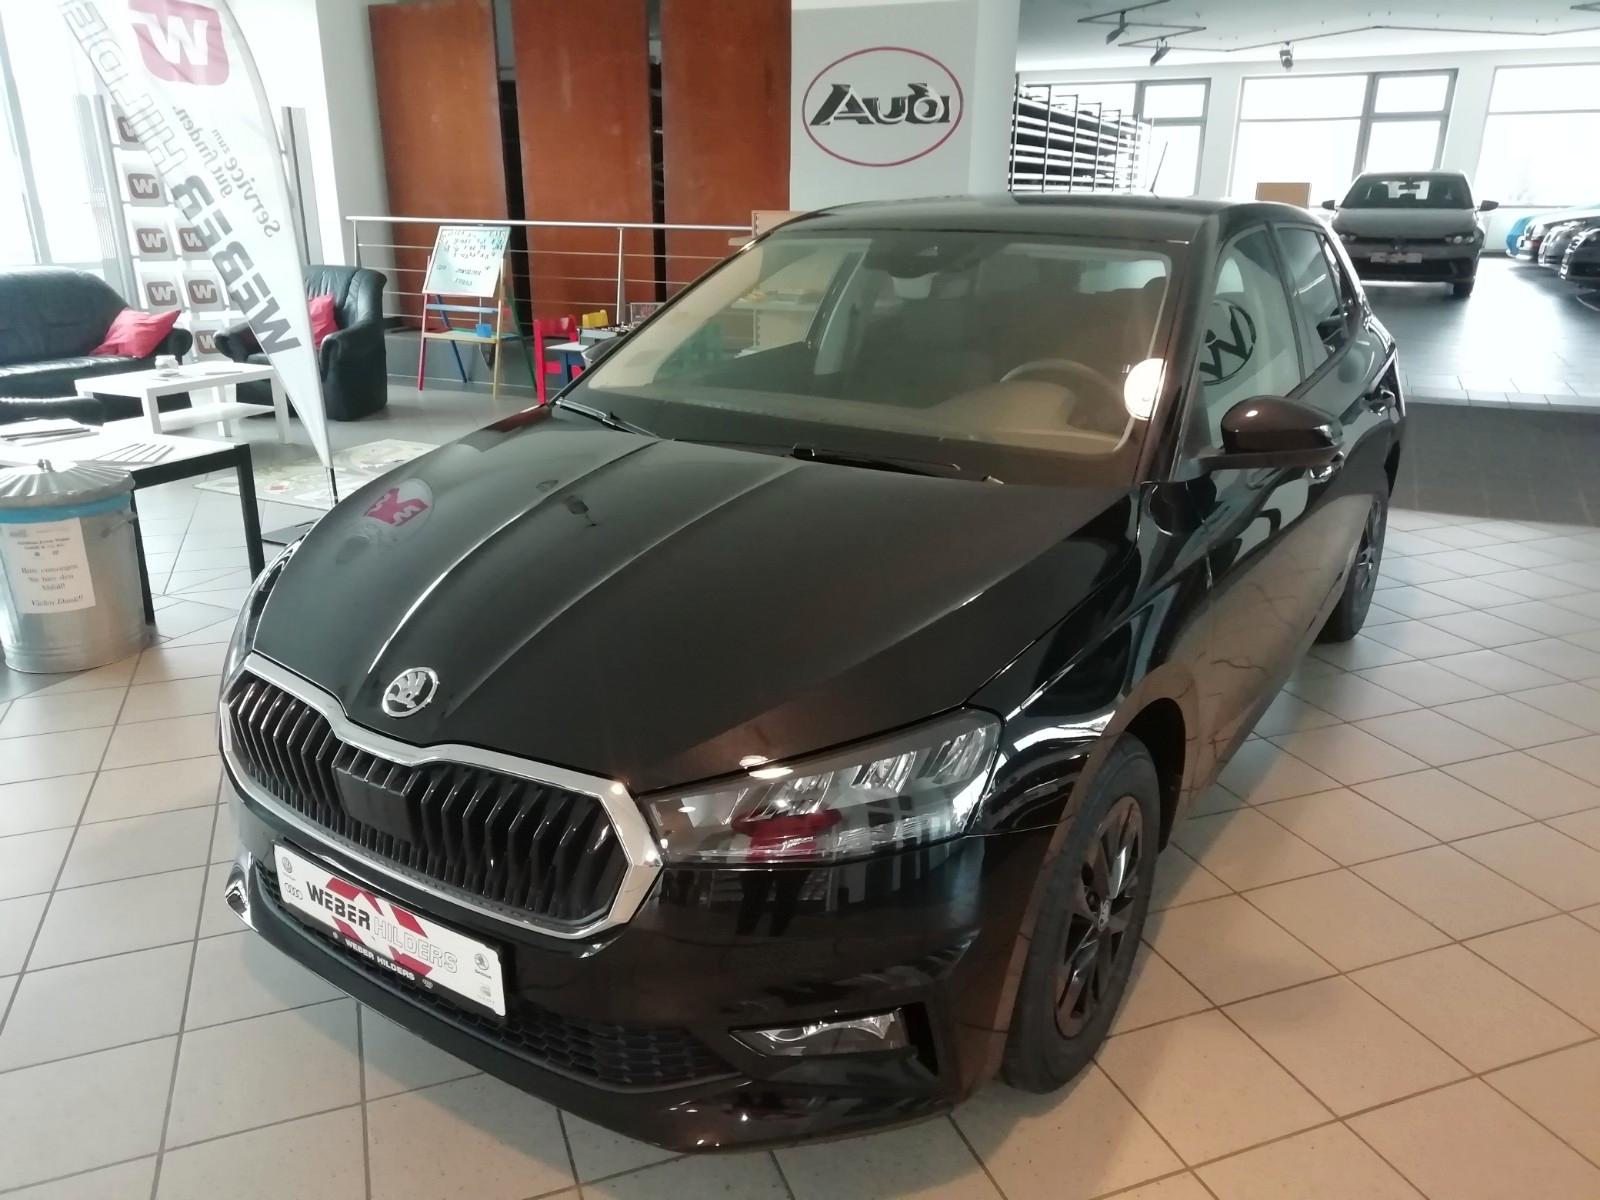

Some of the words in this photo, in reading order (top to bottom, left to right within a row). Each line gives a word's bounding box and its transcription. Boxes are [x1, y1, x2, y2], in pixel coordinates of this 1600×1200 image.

[809, 82, 951, 127] Audi
[306, 880, 371, 931] WEBER
[373, 915, 459, 974] HILDERS
[344, 938, 375, 960] WEBER
[376, 955, 416, 982] HILDERS
